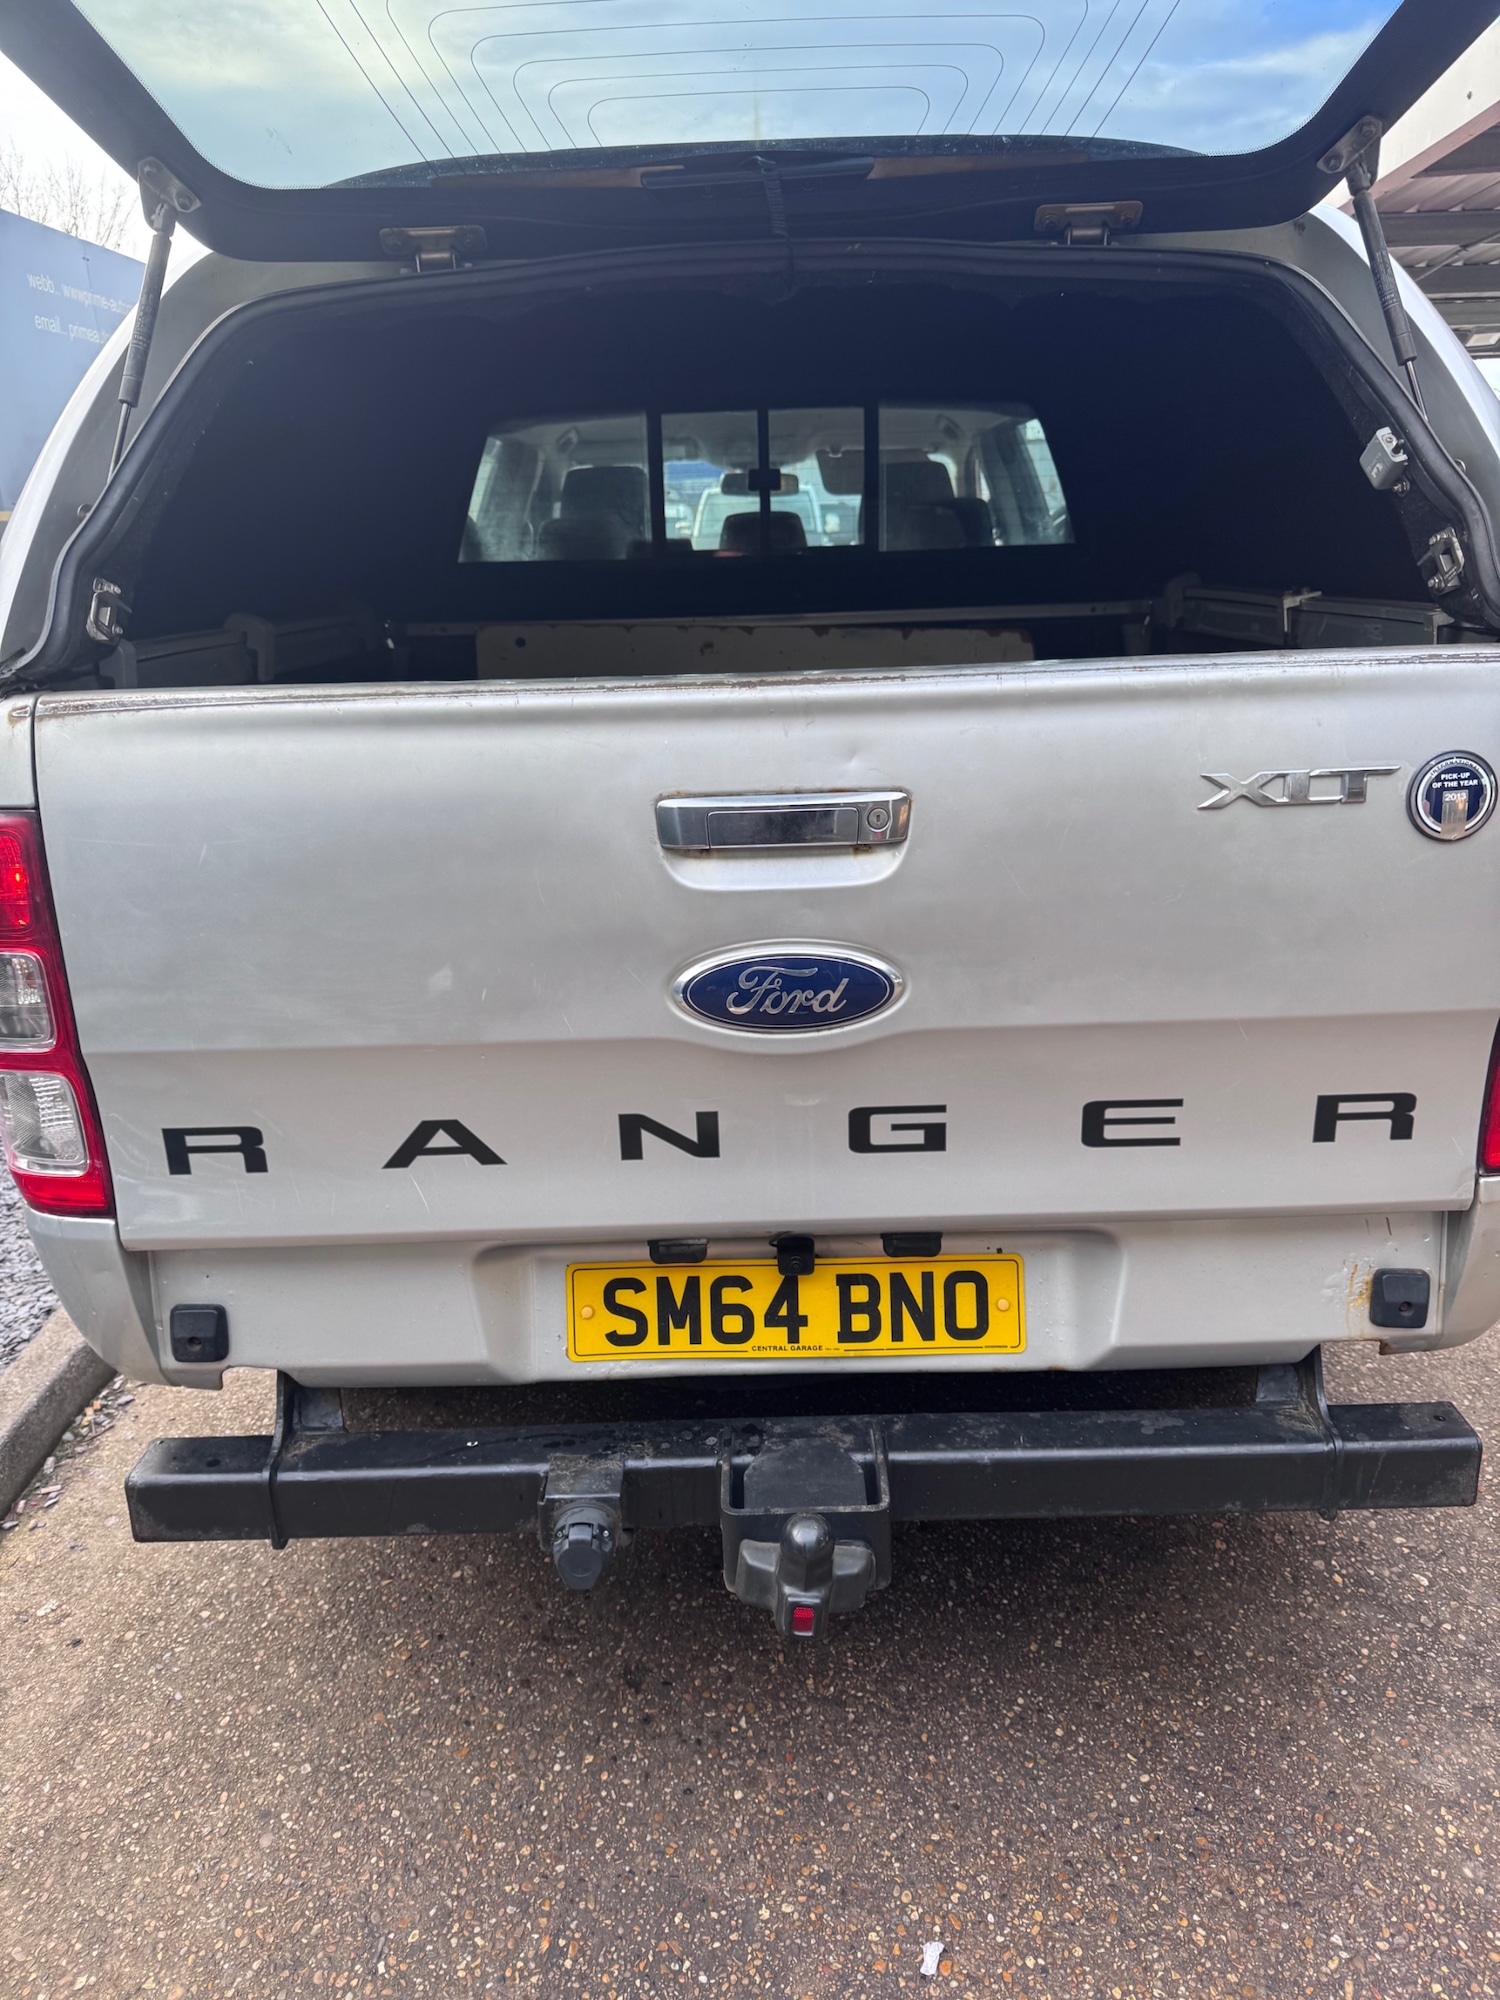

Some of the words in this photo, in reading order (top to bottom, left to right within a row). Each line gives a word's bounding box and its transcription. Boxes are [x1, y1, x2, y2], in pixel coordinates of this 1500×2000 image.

[1197, 766, 1400, 810] XLT
[1440, 772, 1471, 781] PICK-UP
[1444, 780, 1458, 788] THE
[1459, 779, 1479, 787] YEAR
[1444, 792, 1467, 802] 2013
[725, 966, 850, 1016] Ford
[161, 1092, 1418, 1175] RANGER
[602, 1274, 809, 1347] SM64
[835, 1270, 990, 1344] BNO
[789, 1344, 823, 1352] GARAGE
